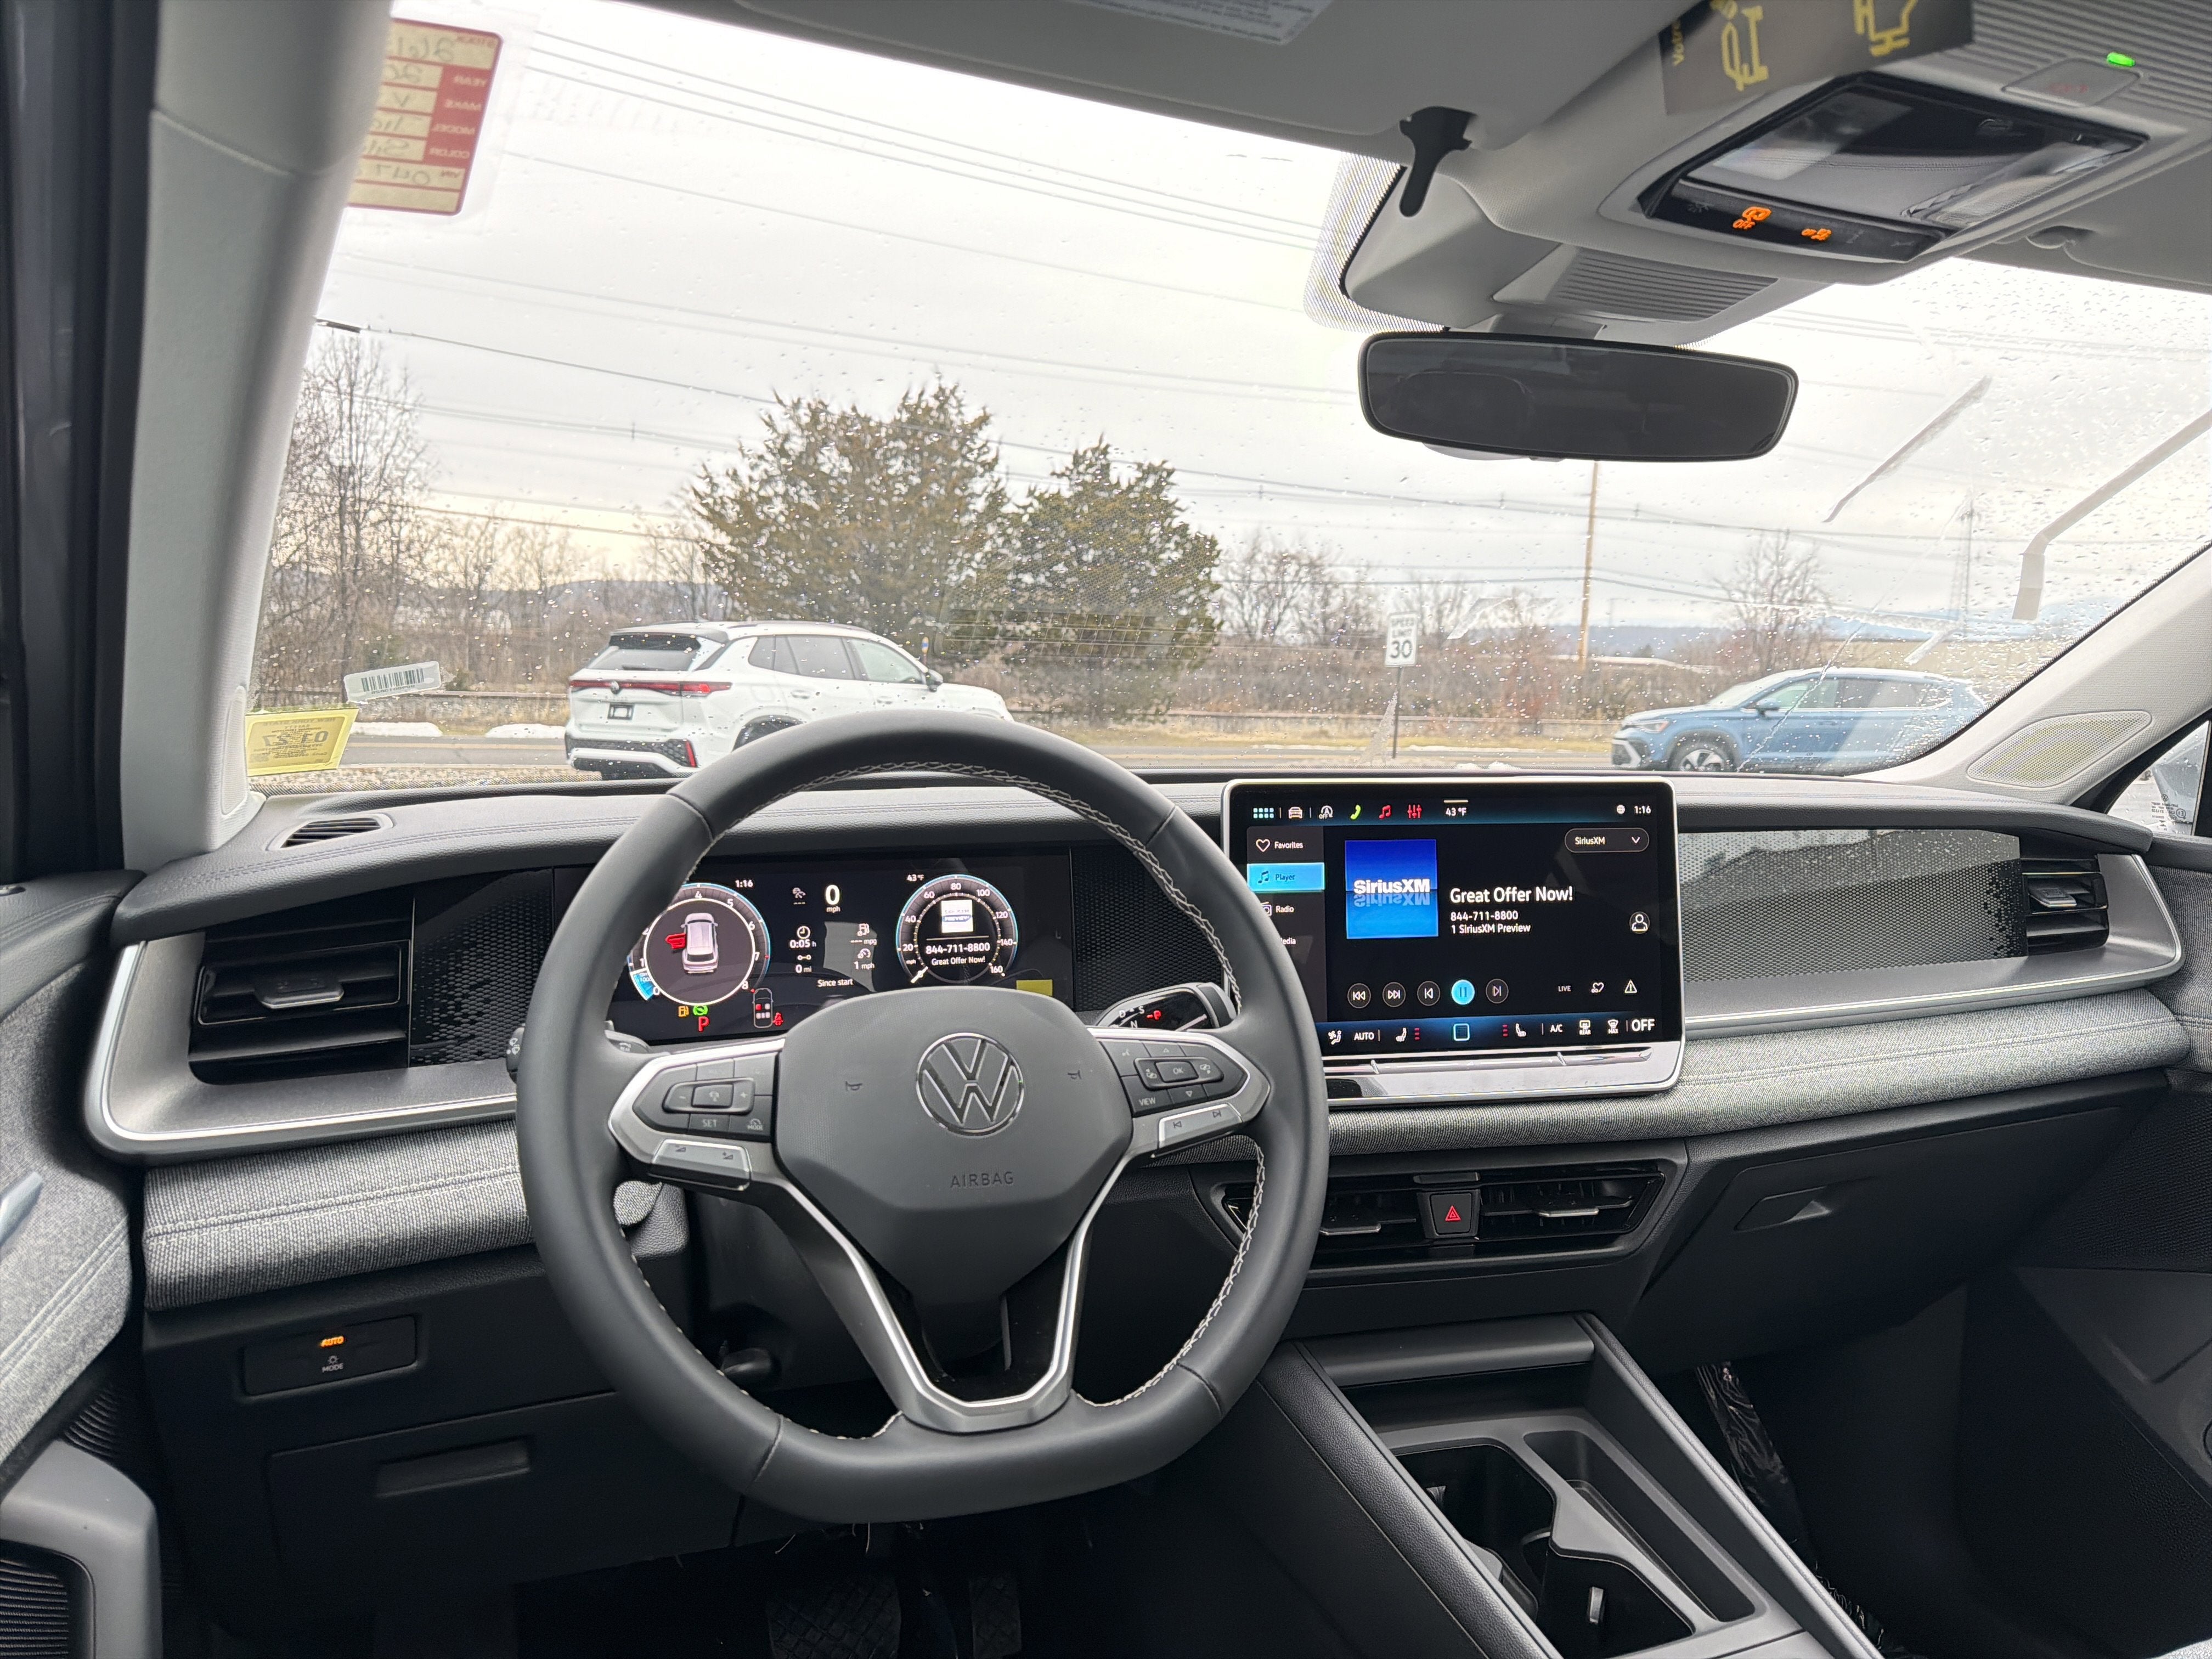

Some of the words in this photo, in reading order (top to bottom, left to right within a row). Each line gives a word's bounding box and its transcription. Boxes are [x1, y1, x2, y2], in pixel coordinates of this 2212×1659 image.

[1733, 219, 1756, 229] OFF
[1390, 640, 1412, 658] 30
[1445, 808, 1457, 816] 43
[1634, 805, 1651, 814] 1:16
[1274, 840, 1304, 849] Favorites
[1575, 837, 1605, 845] SiriusXM
[1275, 873, 1295, 882] Player
[1354, 879, 1430, 894] SiriusXM
[825, 884, 840, 905] 0
[1450, 888, 1489, 904] Great
[1493, 887, 1532, 903] Offer
[1536, 886, 1573, 901] Now!
[1276, 905, 1294, 913] Radio
[1451, 911, 1519, 922] 844-711-8800
[749, 921, 755, 930] 6
[1452, 925, 1456, 934] 1
[1459, 924, 1496, 934] SiriusXM
[1498, 923, 1531, 933] Preview
[789, 939, 810, 949] 0:05
[926, 943, 990, 955] 844-711-8800
[754, 952, 760, 961] 7
[639, 958, 645, 967] 1
[854, 961, 859, 969] 1
[932, 957, 949, 966] Great
[950, 957, 967, 965] Offer
[795, 964, 803, 973] 0
[742, 981, 749, 990] 8
[817, 979, 837, 987] Since
[653, 987, 660, 996] 0
[1119, 1010, 1126, 1018] D
[1138, 1006, 1145, 1014] S
[1154, 1010, 1161, 1020] P
[698, 1016, 709, 1032] P
[1130, 1020, 1138, 1028] N
[1550, 1024, 1563, 1032] A/C
[1631, 1019, 1655, 1032] OFF
[1353, 1032, 1374, 1041] AUTO
[1139, 1097, 1156, 1105] VIEW
[702, 1119, 718, 1127] SET
[950, 1171, 1014, 1188] AIRBAG
[320, 1336, 345, 1347] AUTO
[321, 1363, 343, 1373] MODE
